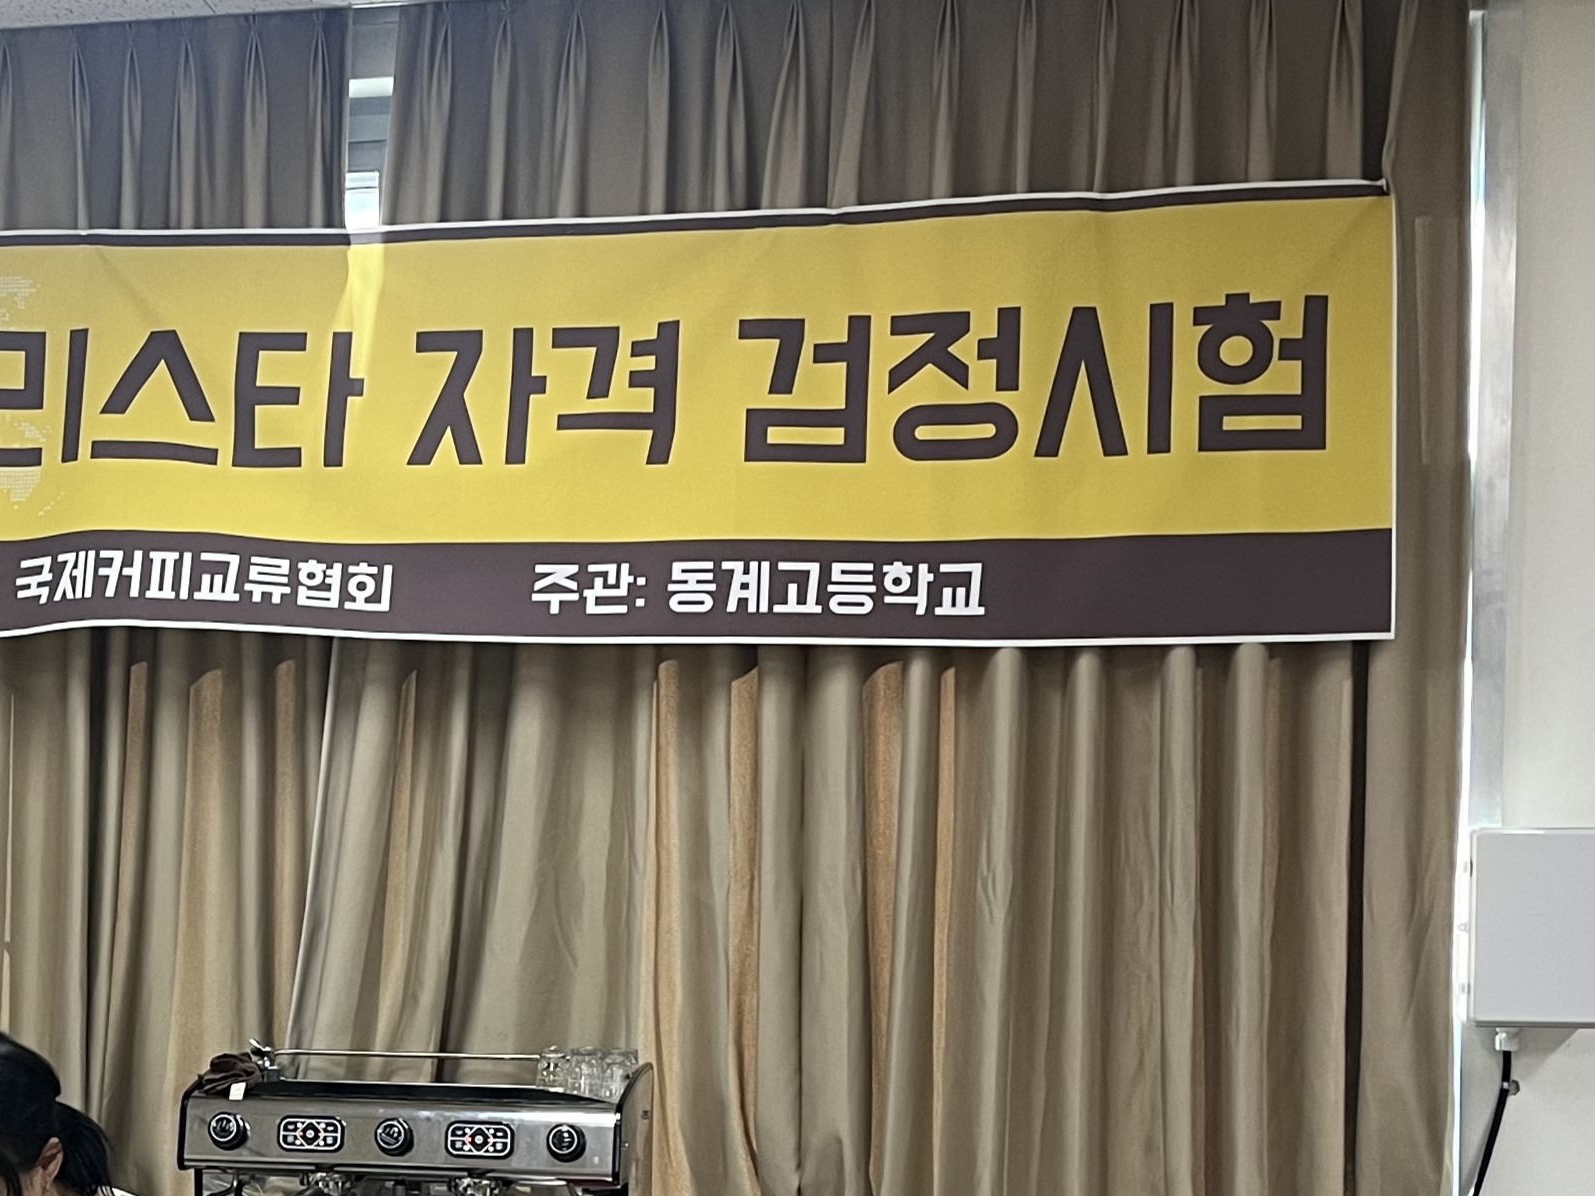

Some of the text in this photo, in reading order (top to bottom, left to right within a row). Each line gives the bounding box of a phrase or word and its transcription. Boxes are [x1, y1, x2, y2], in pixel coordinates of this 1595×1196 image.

[407, 320, 681, 466] 자격
[737, 292, 1328, 463] 검정시험
[15, 549, 393, 613] 국제커피교류협회
[531, 560, 985, 616] 주관: 동계고등학교
